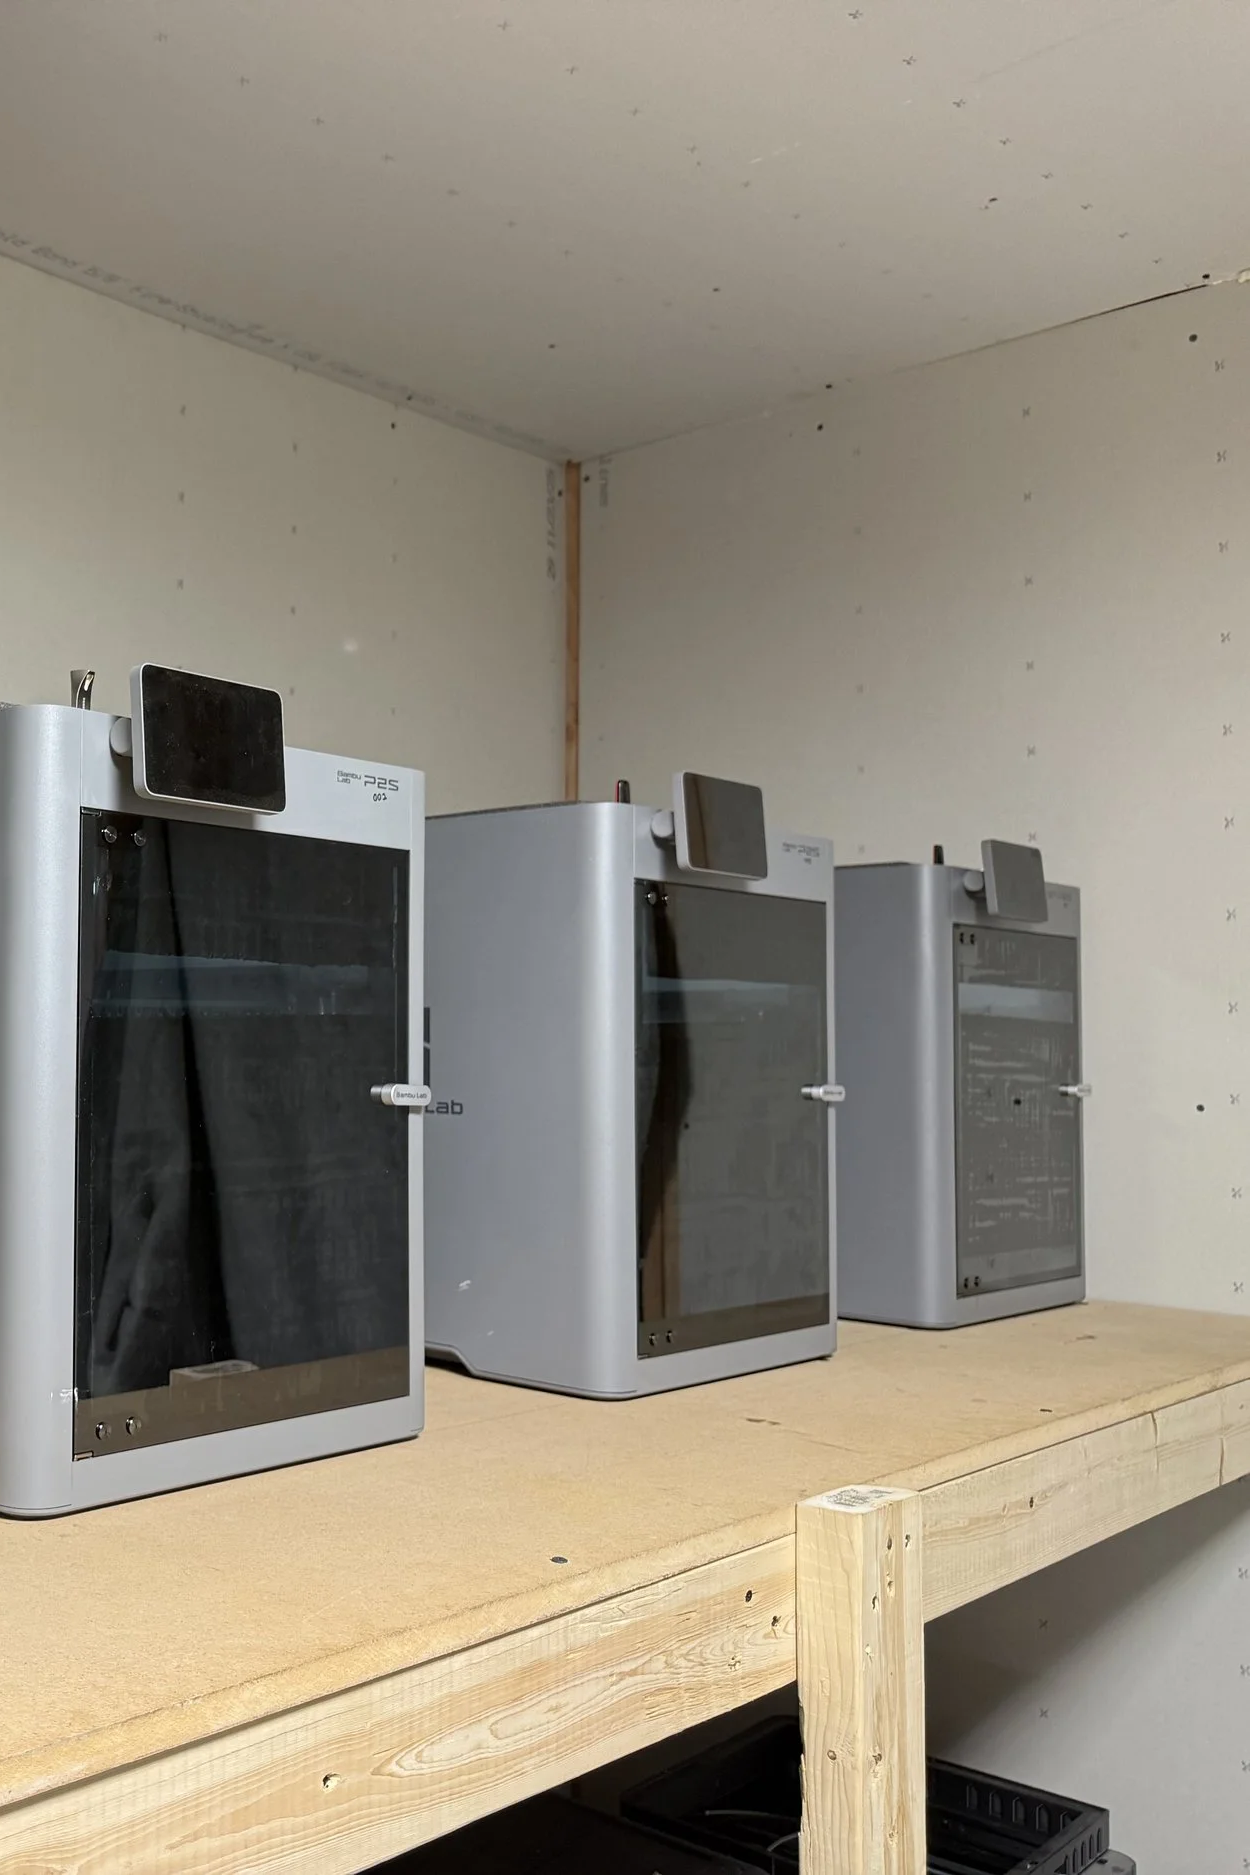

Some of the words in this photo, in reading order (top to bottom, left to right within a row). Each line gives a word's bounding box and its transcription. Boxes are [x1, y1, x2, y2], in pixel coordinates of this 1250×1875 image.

[336, 776, 351, 784] Lab
[337, 770, 362, 780] Bambu
[364, 774, 399, 792] P2S
[396, 1091, 416, 1099] Bambu
[417, 1091, 427, 1099] Lab
[424, 1099, 464, 1115] Lab
